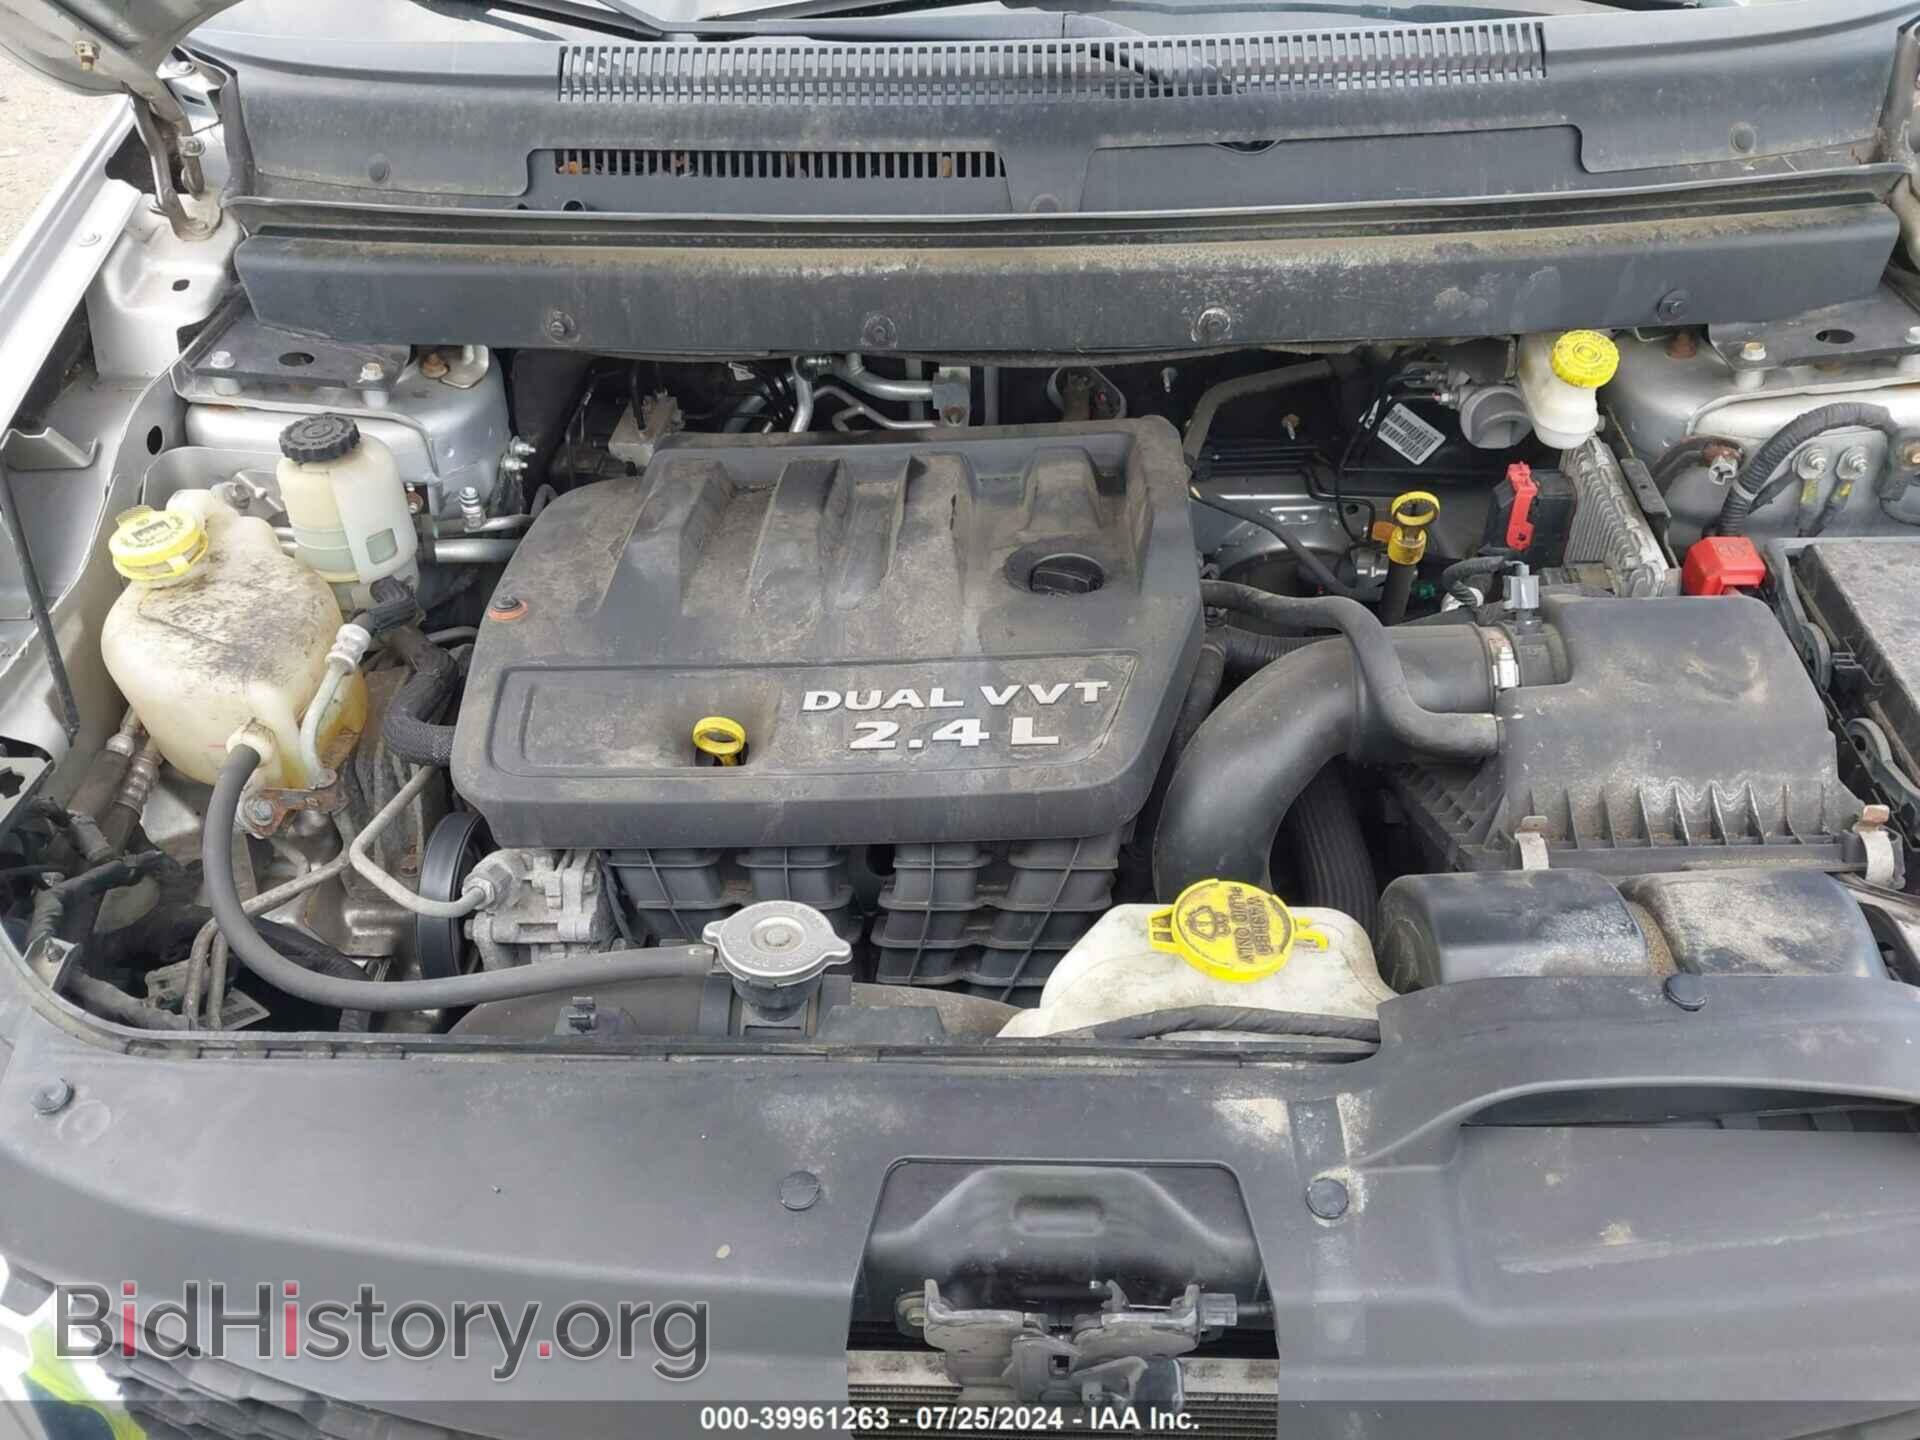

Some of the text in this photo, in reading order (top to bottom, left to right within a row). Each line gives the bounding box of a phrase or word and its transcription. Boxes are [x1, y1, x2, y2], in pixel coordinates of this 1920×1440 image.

[802, 681, 1111, 712] DUAL VVT
[849, 717, 1060, 750] 2.4 L
[1228, 886, 1255, 965] FLUID ONLY
[1247, 895, 1274, 956] WASHER
